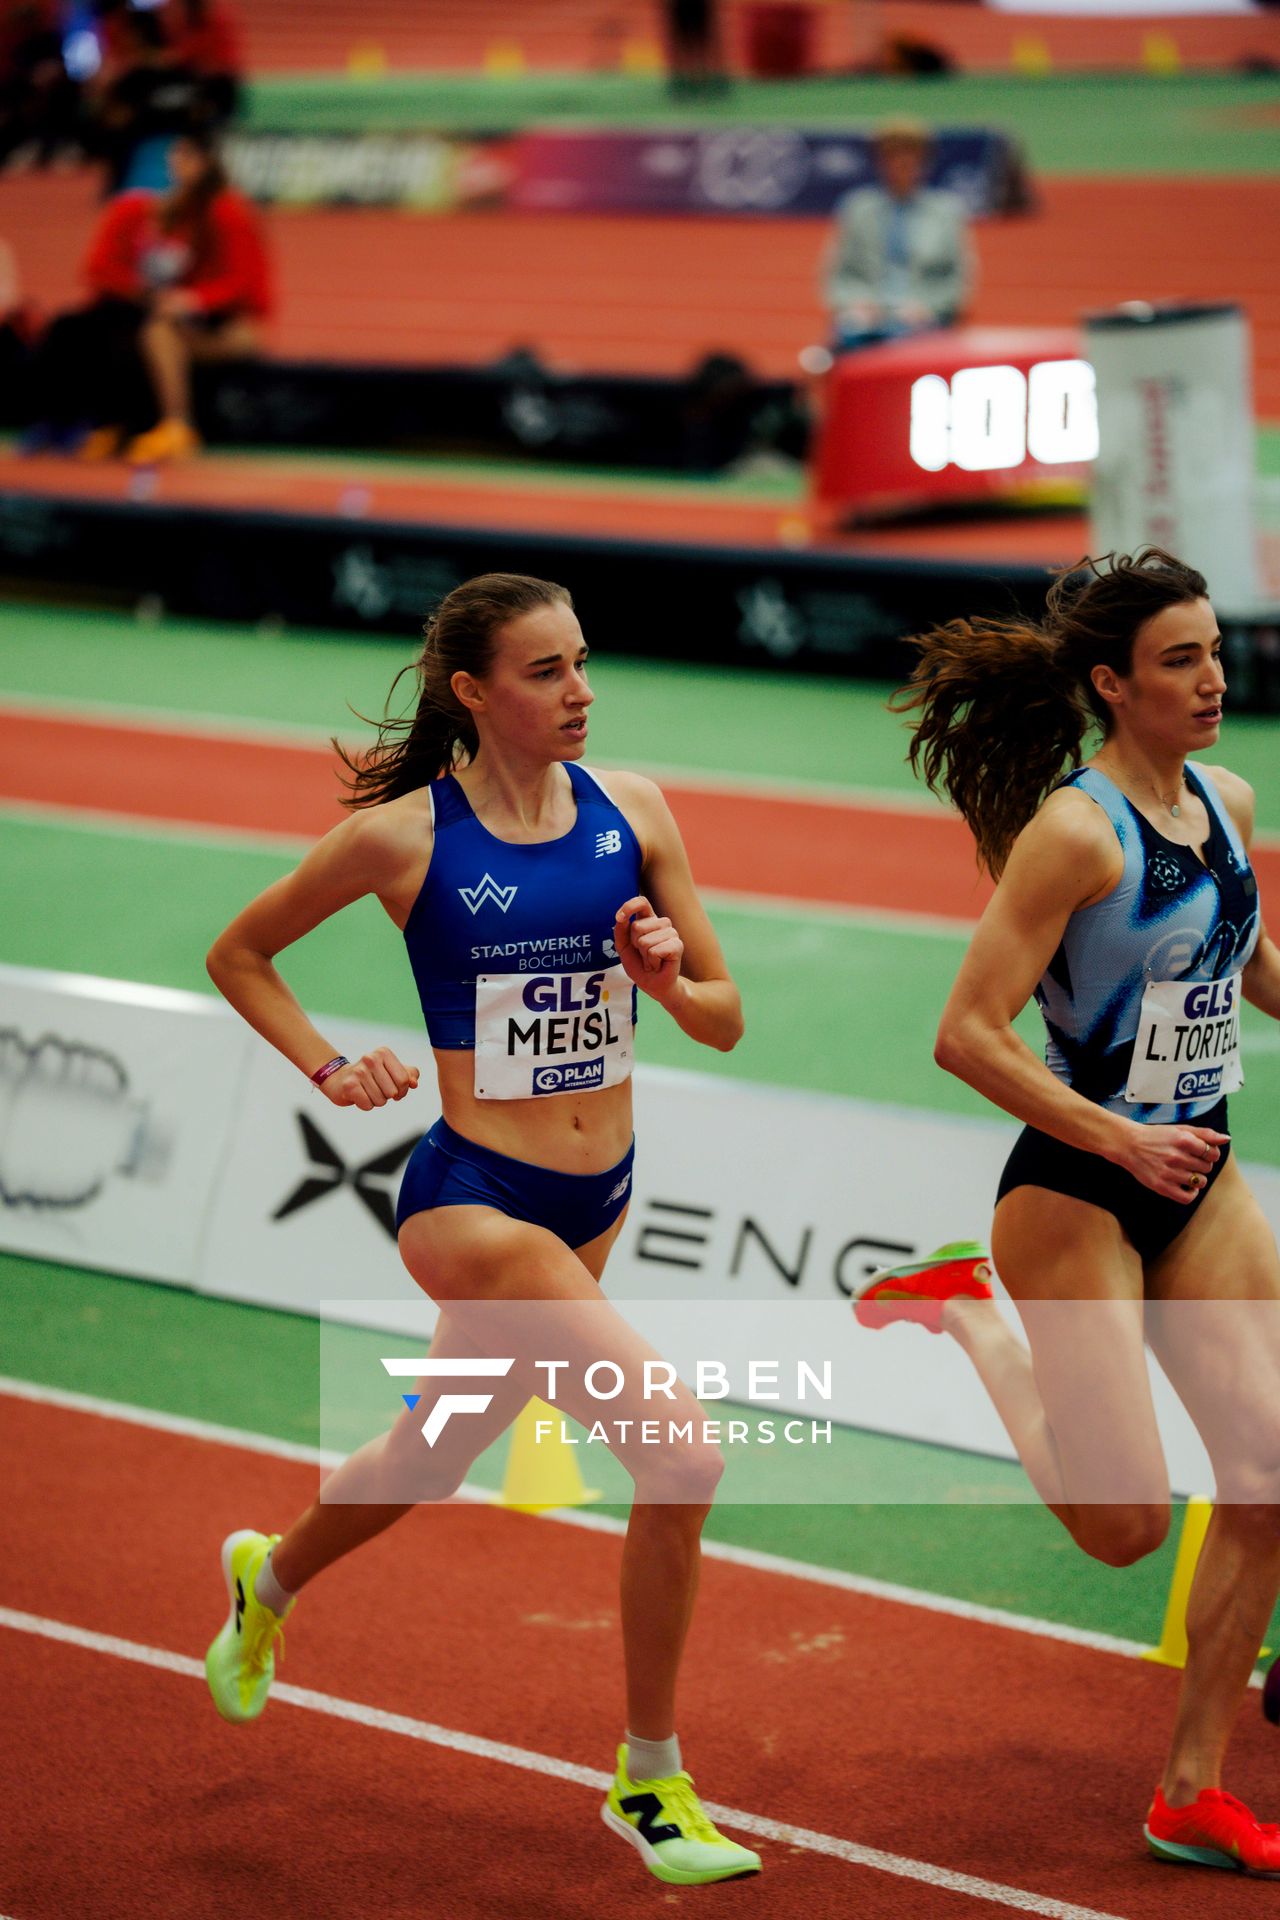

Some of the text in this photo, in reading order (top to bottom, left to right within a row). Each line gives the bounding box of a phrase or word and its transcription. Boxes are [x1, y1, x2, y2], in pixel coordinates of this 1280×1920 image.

[471, 935, 591, 959] STADTWERKE
[518, 951, 592, 971] BOCHUM
[508, 1008, 618, 1056] MEISL
[565, 1063, 602, 1081] PLAN
